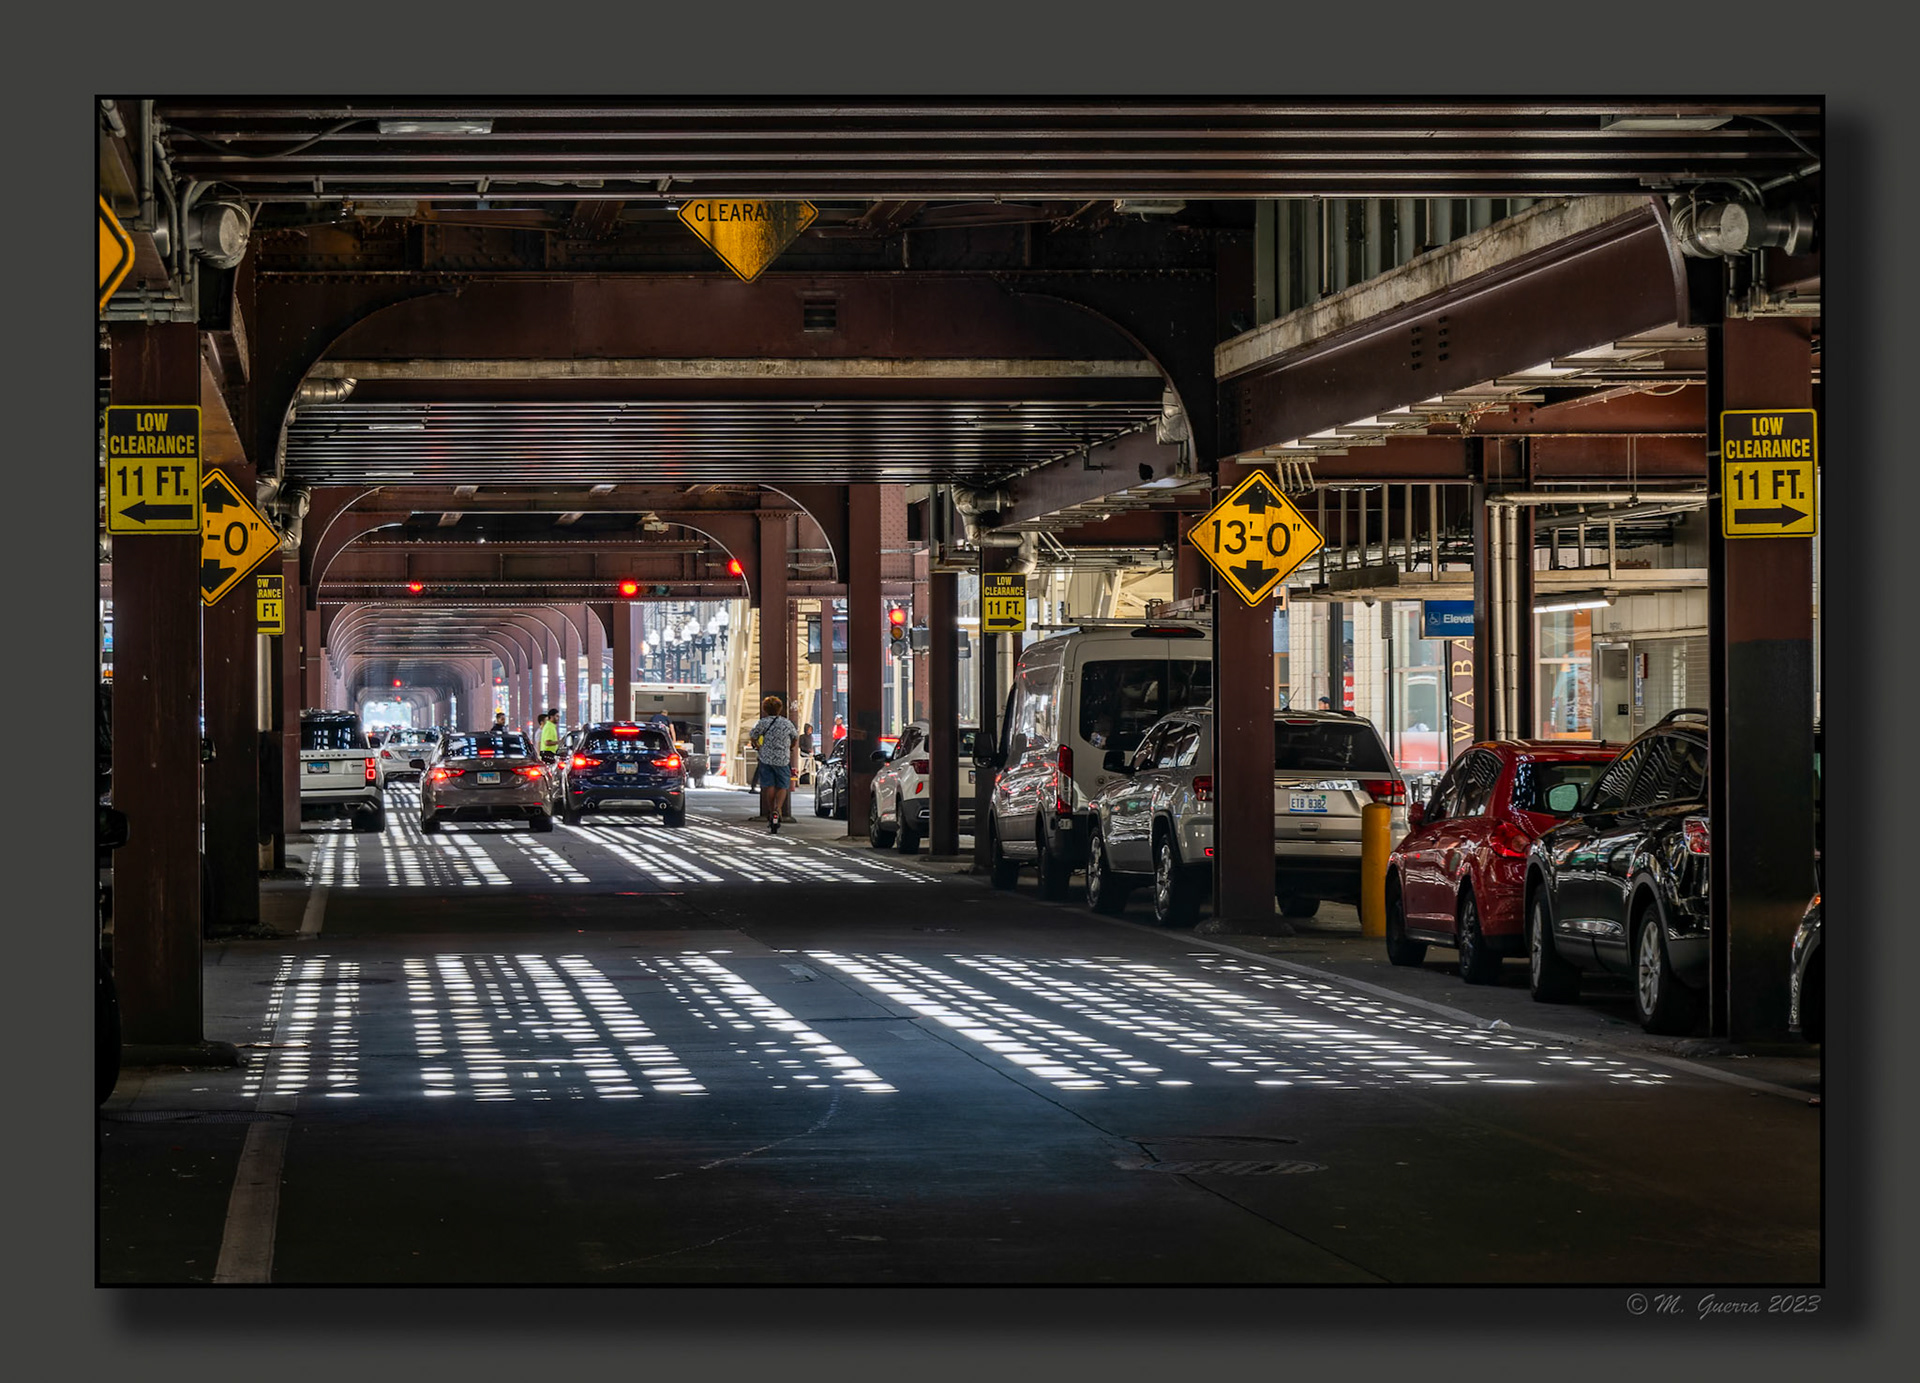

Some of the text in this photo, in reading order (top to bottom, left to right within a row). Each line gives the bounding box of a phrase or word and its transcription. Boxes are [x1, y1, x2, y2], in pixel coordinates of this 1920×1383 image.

[694, 203, 804, 222] CLEARANE
[136, 413, 168, 432] LOW
[1752, 417, 1784, 436] LOW
[110, 435, 195, 454] CLEARANCE
[1725, 439, 1810, 459] CLEARANCE
[117, 466, 189, 496] 11 FT.
[1733, 469, 1804, 500] 11 FT.
[201, 520, 258, 555] '-0"
[257, 578, 269, 588] OW
[996, 576, 1012, 586] LOW
[257, 588, 281, 598] RANCE
[985, 587, 1024, 596] CLEARANCE
[263, 603, 278, 617] FT.
[988, 601, 1021, 615] 11 FT.
[1443, 614, 1475, 624] Elevat
